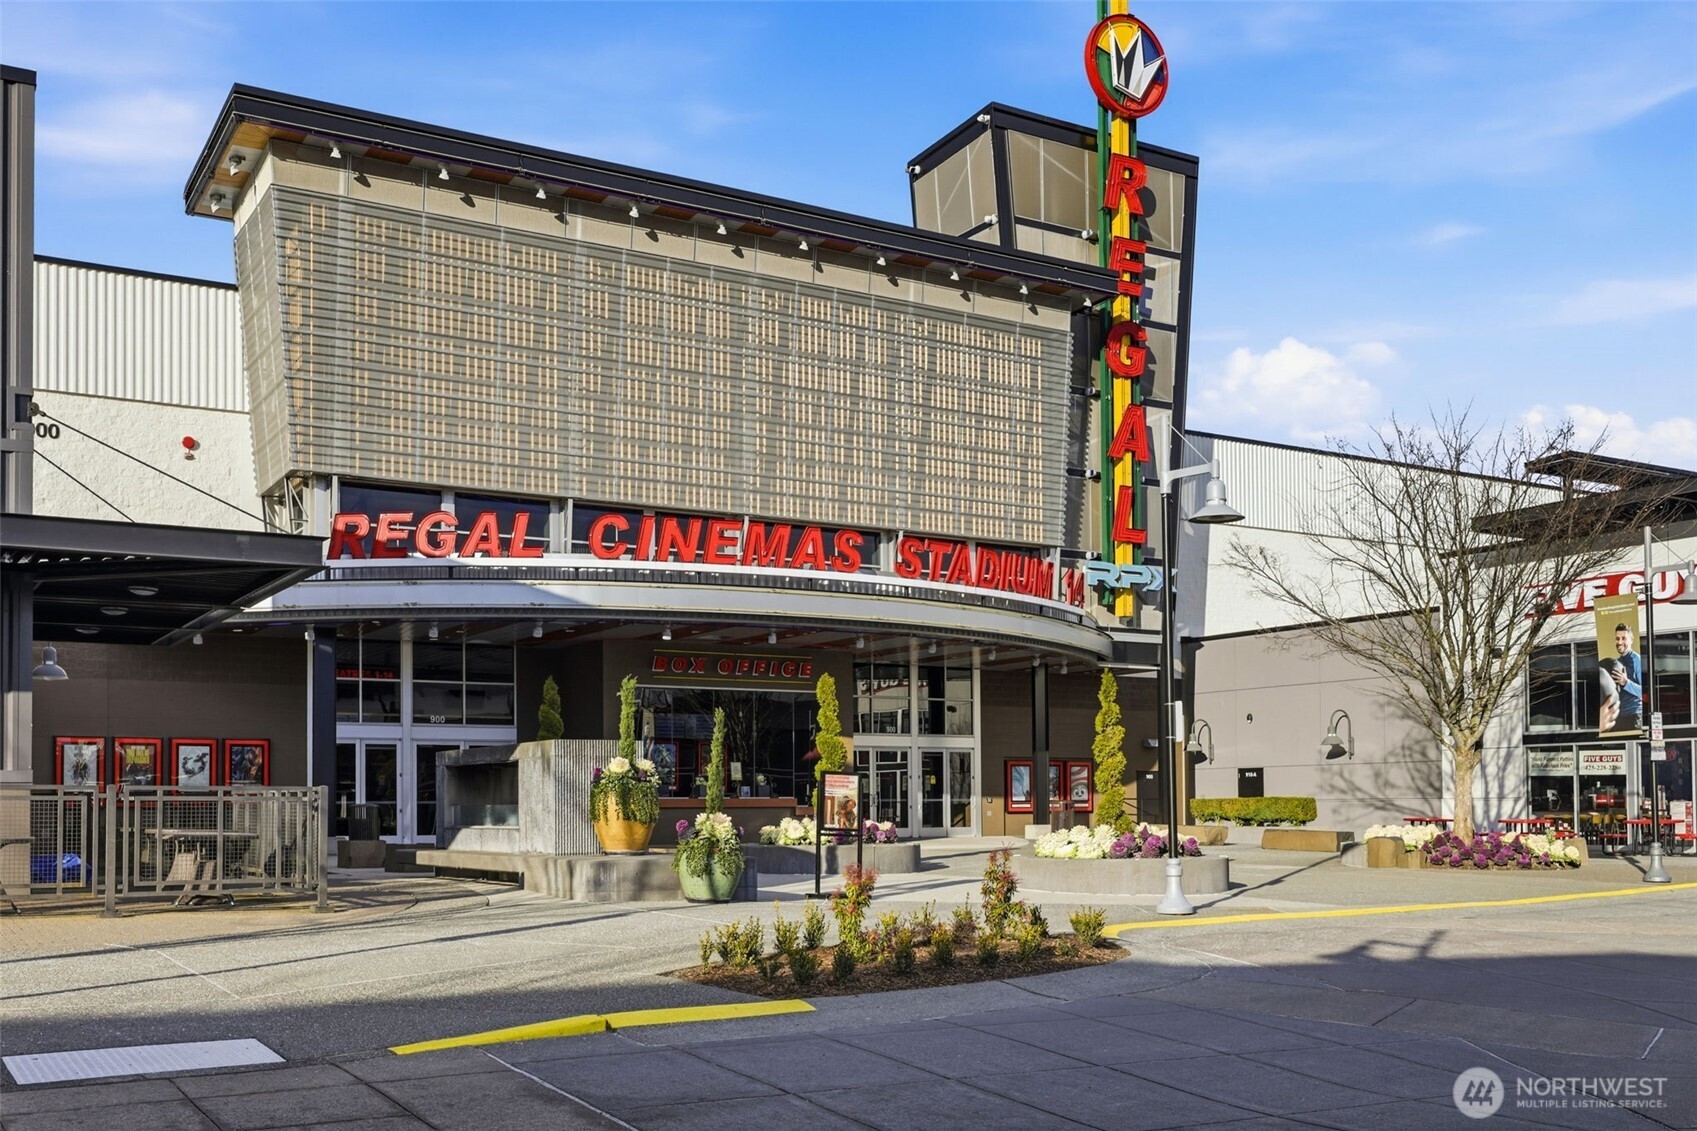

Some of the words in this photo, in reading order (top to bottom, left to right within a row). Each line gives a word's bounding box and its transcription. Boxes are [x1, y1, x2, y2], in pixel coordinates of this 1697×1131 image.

[1104, 153, 1150, 544] REGAL
[327, 511, 544, 560] REGAL
[588, 512, 864, 572] CINEMAS
[896, 536, 1054, 600] STADIUM
[1064, 567, 1085, 609] 14
[652, 655, 707, 674] BOX
[717, 658, 813, 678] OFFICE
[430, 715, 445, 723] 900
